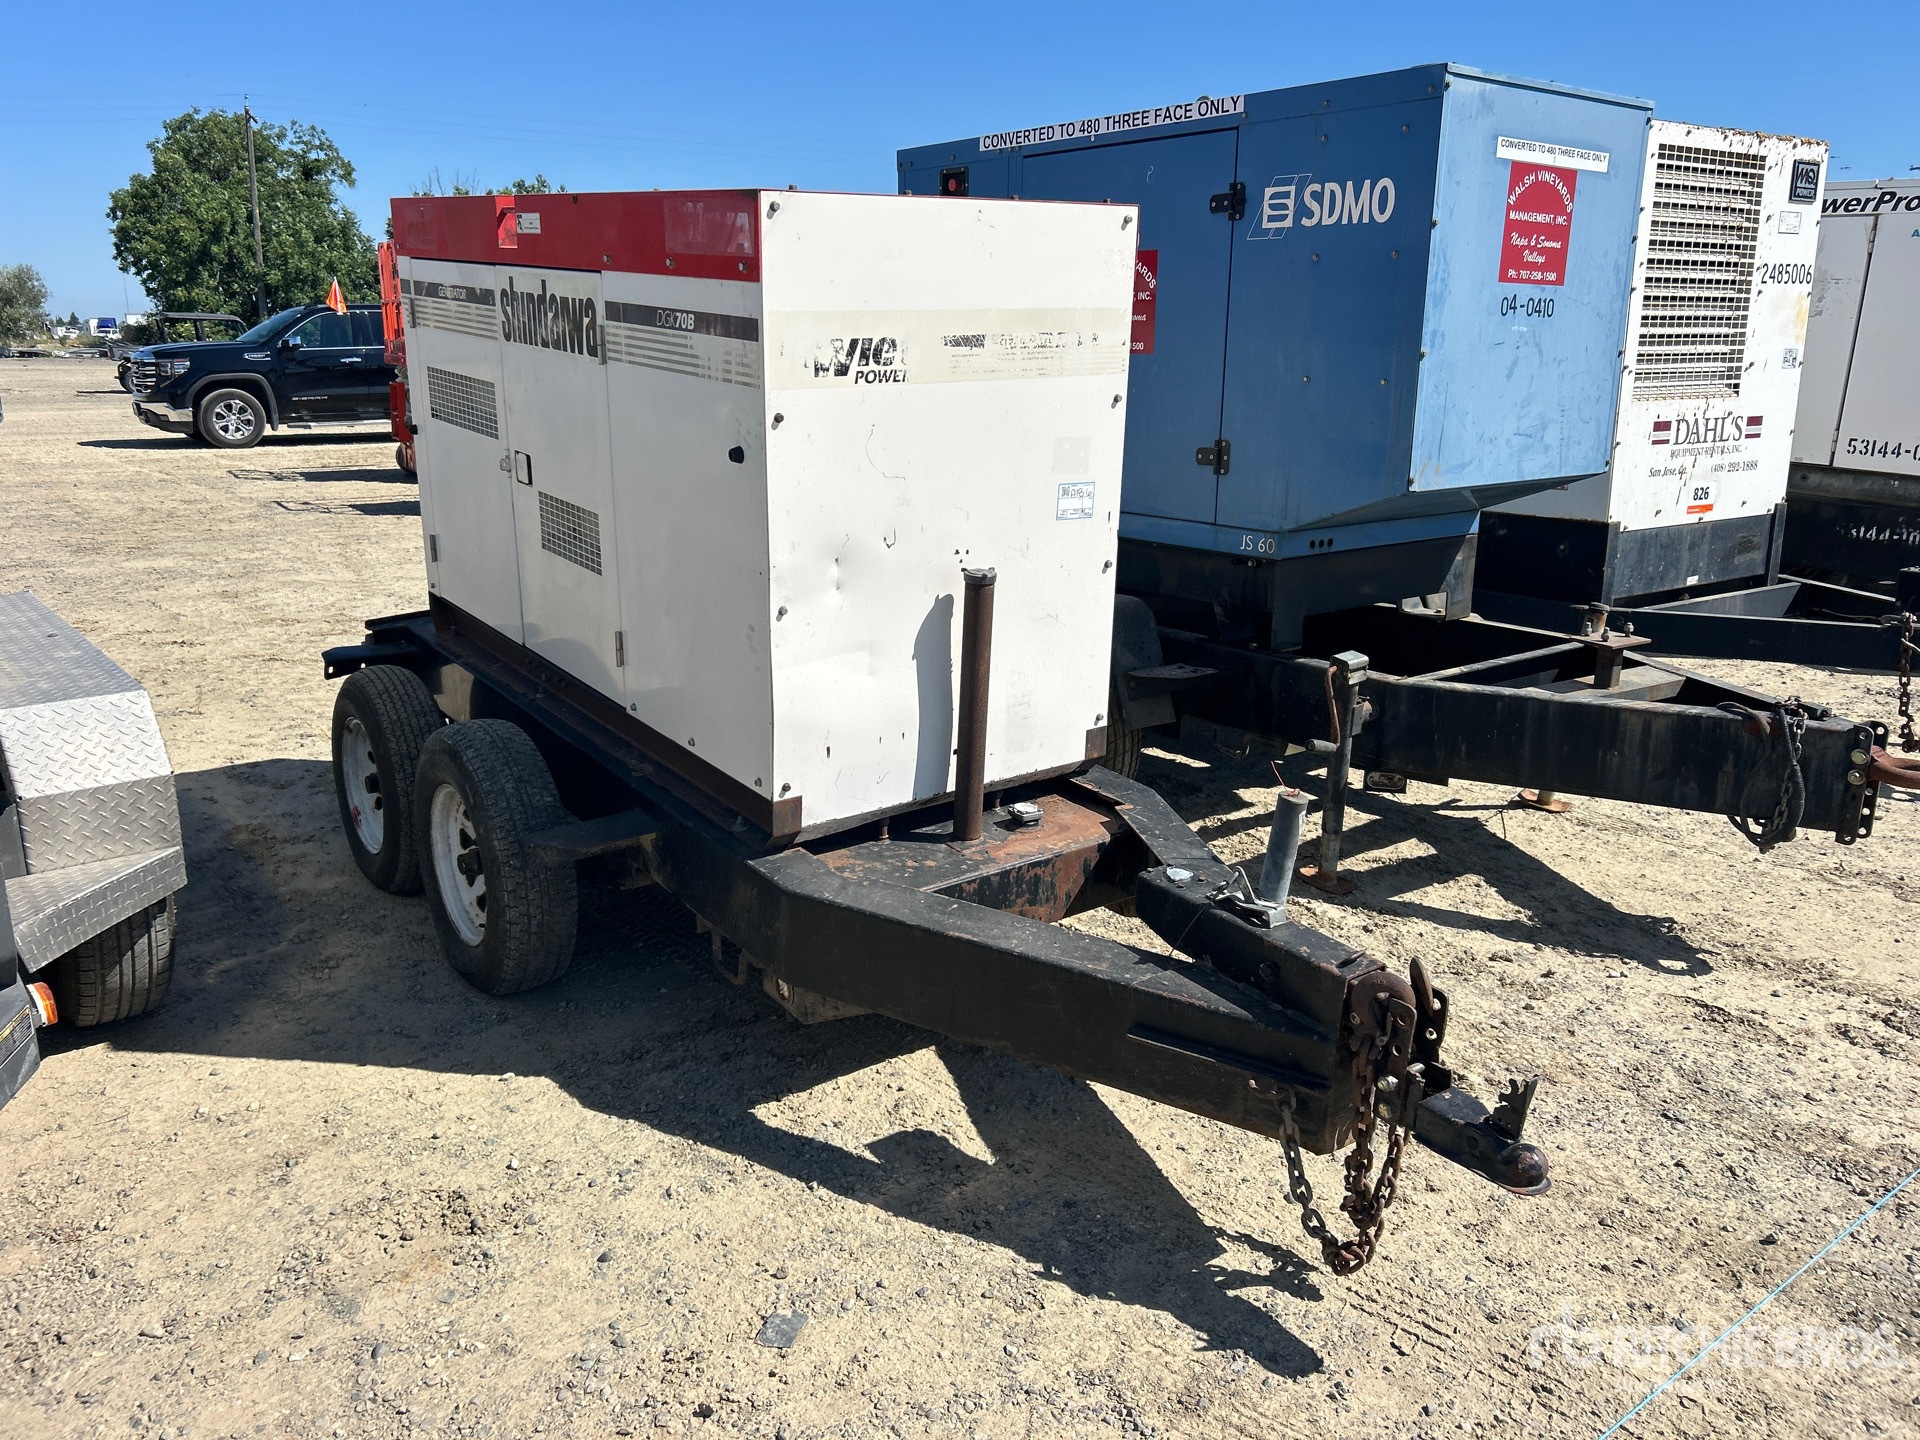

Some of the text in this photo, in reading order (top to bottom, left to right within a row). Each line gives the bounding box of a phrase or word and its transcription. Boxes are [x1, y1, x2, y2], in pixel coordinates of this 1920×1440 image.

[983, 95, 1242, 149] CONVERTED TO 480 THREE FACE ONLY
[1501, 139, 1607, 162] CONVERTED TO 480 THREE FACE ONLY
[1301, 177, 1396, 227] SDMO
[1508, 170, 1573, 213] WALSH VINEYARDS
[1795, 189, 1815, 198] POWER
[1509, 210, 1568, 226] MANAGEMENT, INC.
[1510, 232, 1562, 249] Napa & Sonoma
[1523, 249, 1546, 266] Valleys
[1761, 263, 1812, 285] 2485006
[1501, 294, 1555, 318] 04-0410
[656, 309, 695, 330] DGK70B
[1673, 415, 1743, 445] DAHL'S
[1648, 468, 1661, 477] San
[1711, 463, 1726, 473] (408)
[1727, 460, 1758, 472] 292-1888
[1693, 486, 1709, 501] 826
[1240, 535, 1275, 554] JS 60
